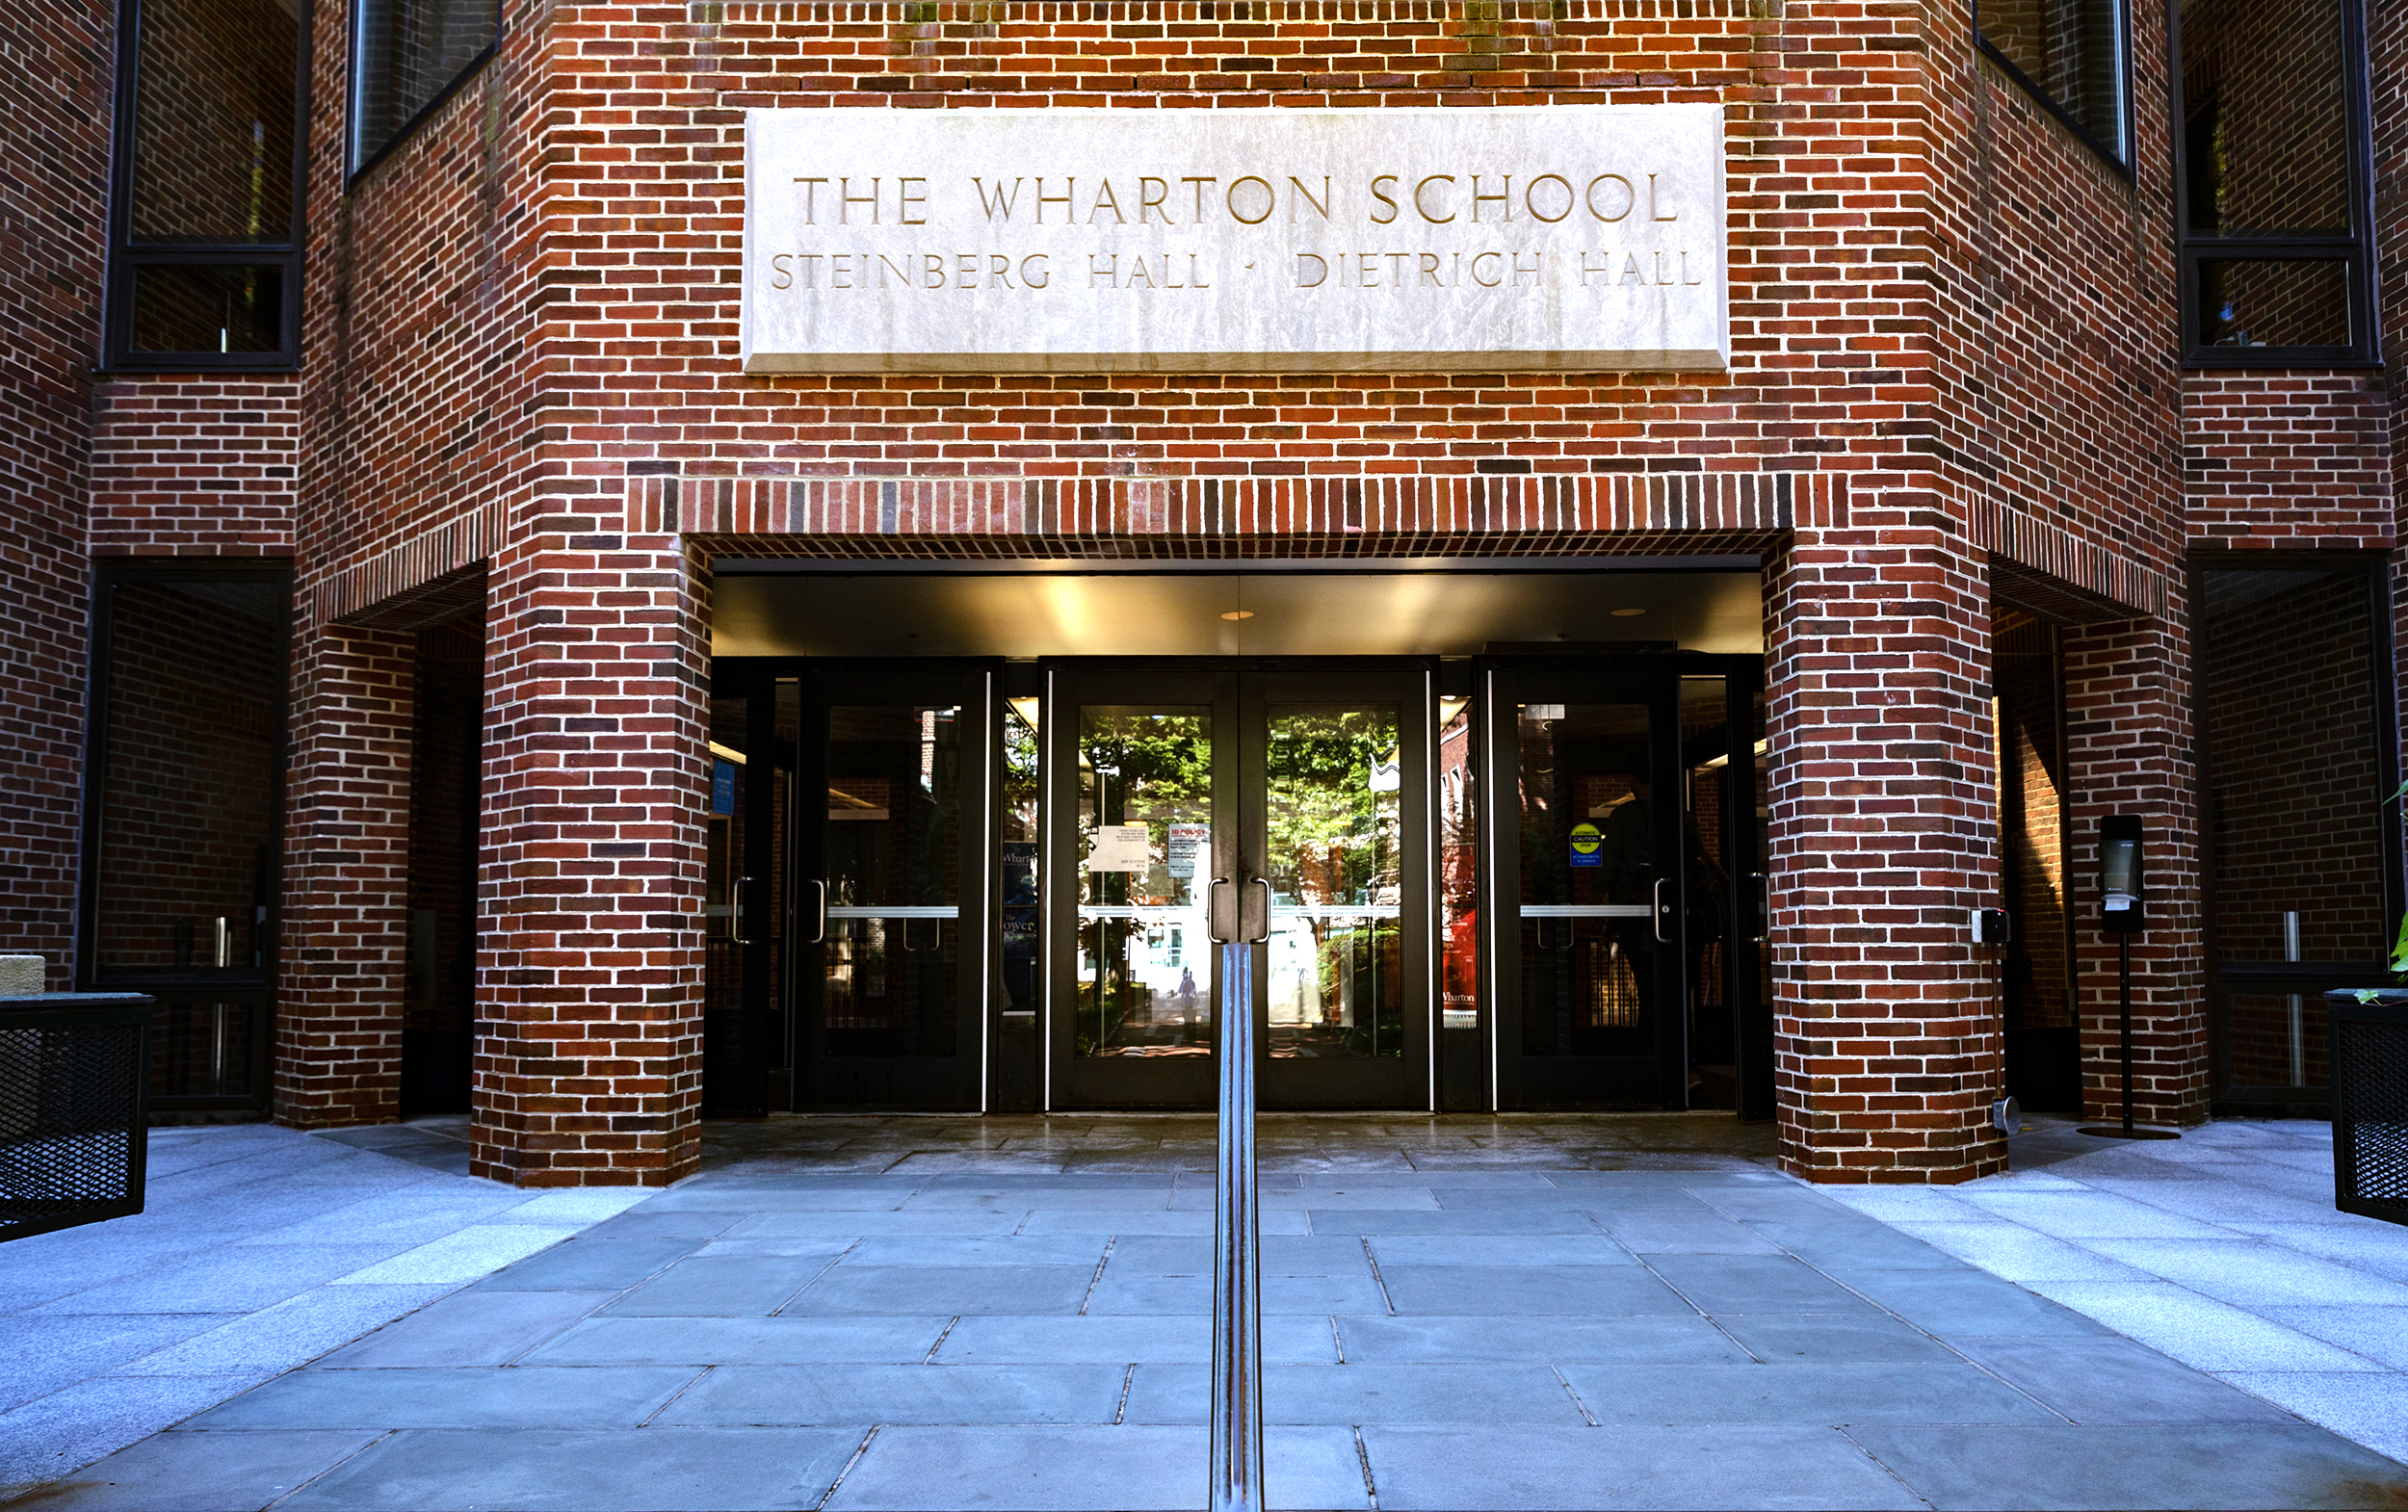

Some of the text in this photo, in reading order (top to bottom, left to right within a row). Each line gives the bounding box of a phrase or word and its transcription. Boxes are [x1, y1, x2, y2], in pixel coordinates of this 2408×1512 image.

[793, 172, 1679, 225] THE WHARTON SCHOOL
[771, 250, 1702, 290] STEINBERG HALL DIETRICH HALL
[1003, 853, 1034, 863] Whart
[1003, 922, 1035, 931] ower
